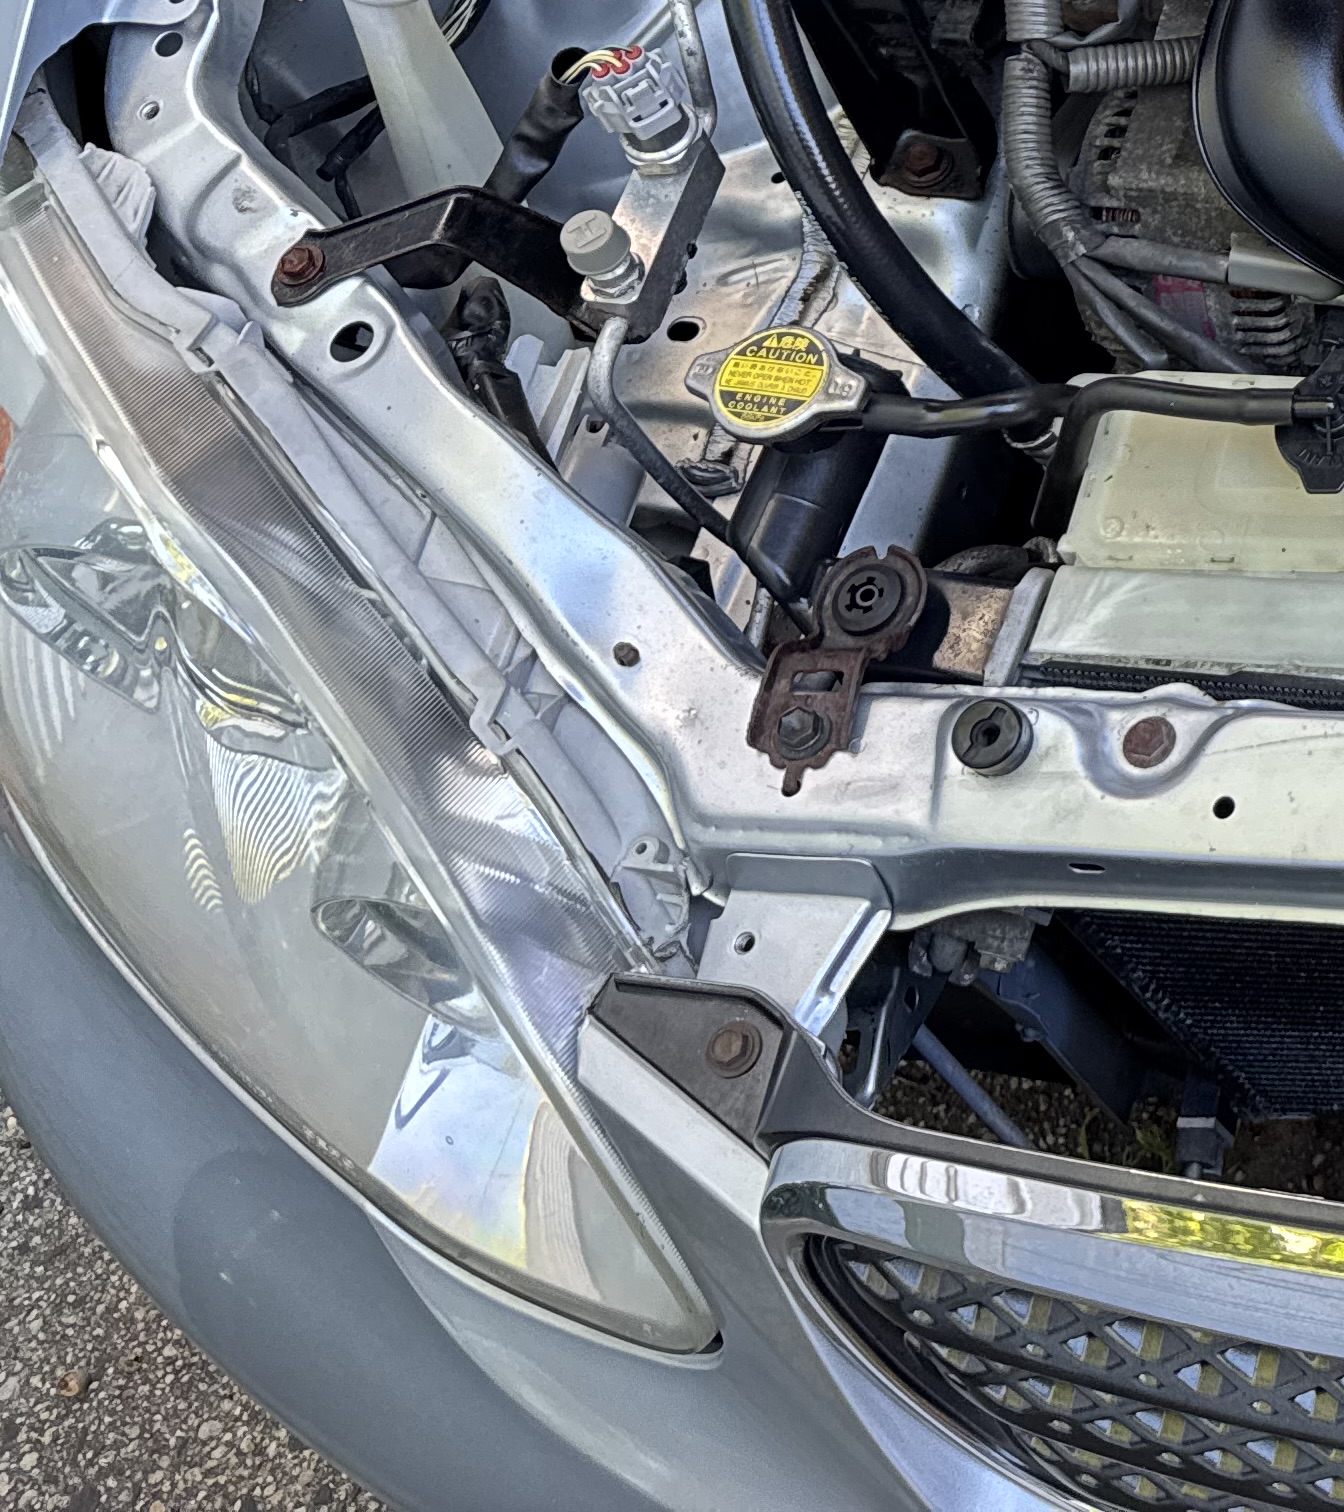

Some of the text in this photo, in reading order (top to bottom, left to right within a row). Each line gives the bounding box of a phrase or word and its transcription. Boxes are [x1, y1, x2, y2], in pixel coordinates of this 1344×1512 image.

[745, 346, 819, 365] CAUTION
[728, 369, 812, 386] NEVER OPEN WHEN HOT
[735, 392, 787, 406] ENGINE
[728, 400, 787, 415] COOLANT
